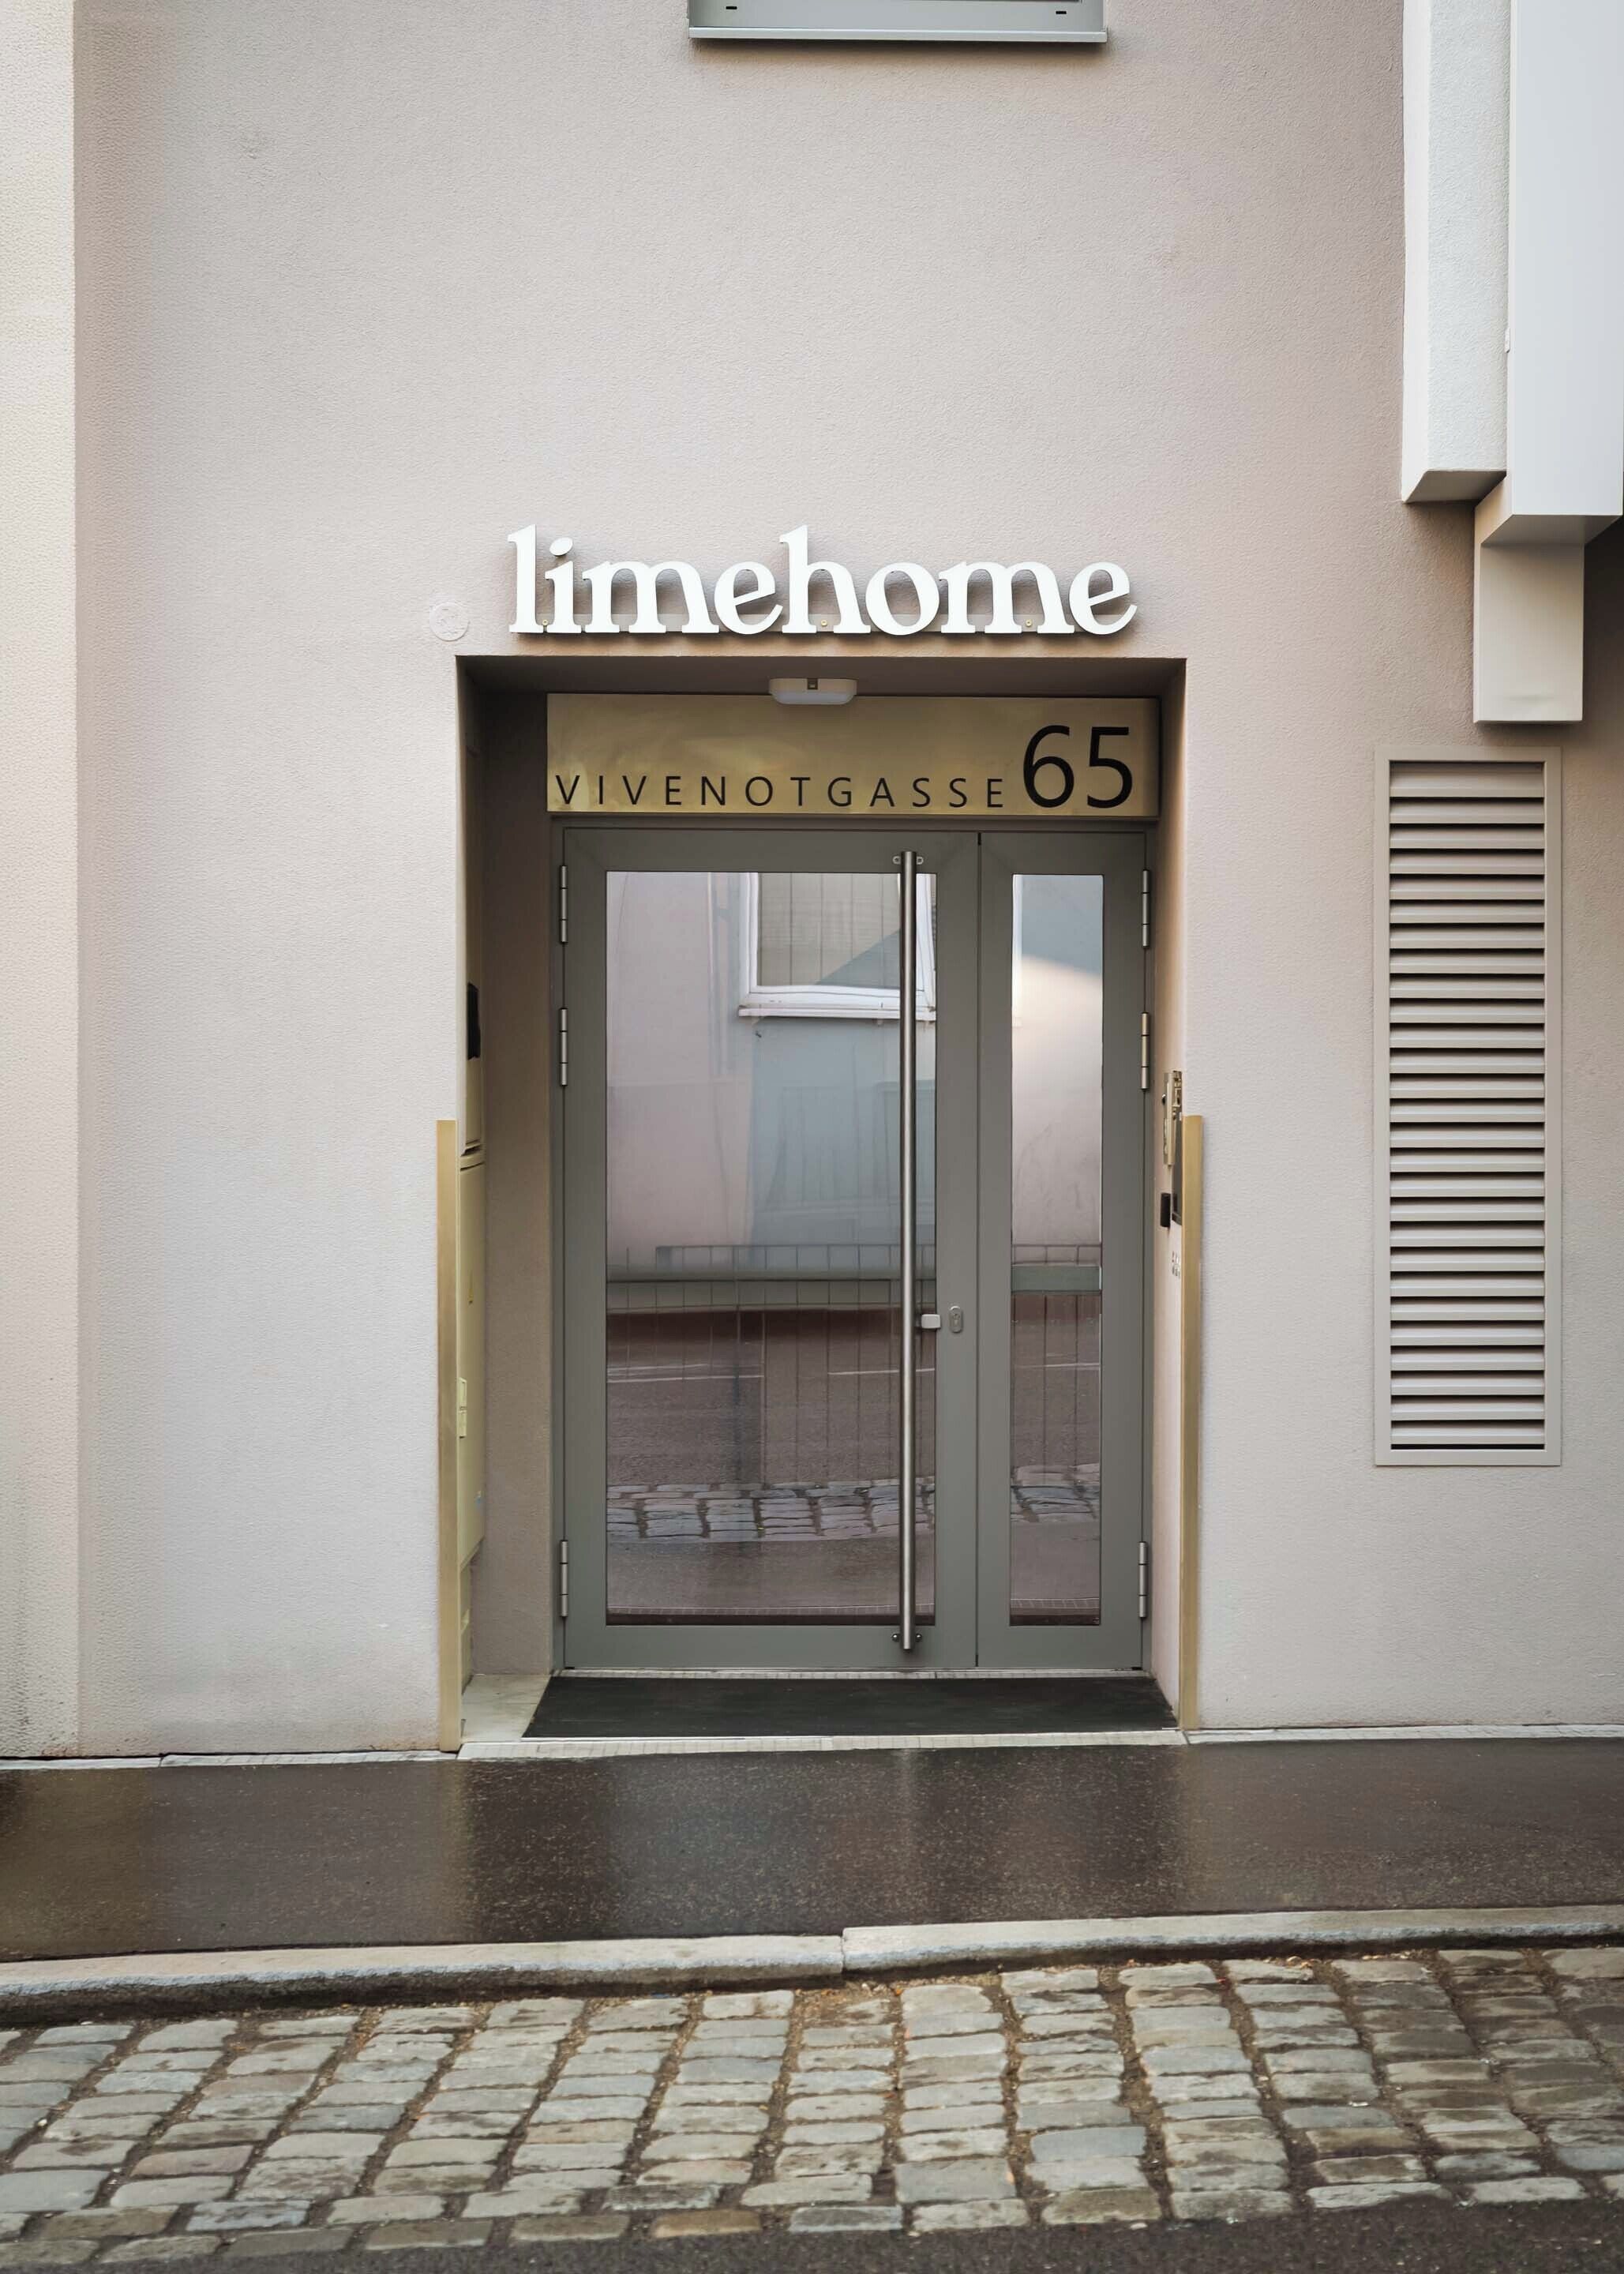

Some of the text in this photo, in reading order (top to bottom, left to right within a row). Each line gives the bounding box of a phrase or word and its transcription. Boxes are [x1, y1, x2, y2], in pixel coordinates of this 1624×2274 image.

[508, 524, 1138, 636] limehome
[555, 725, 1133, 809] VIVENOTGASSE 65
